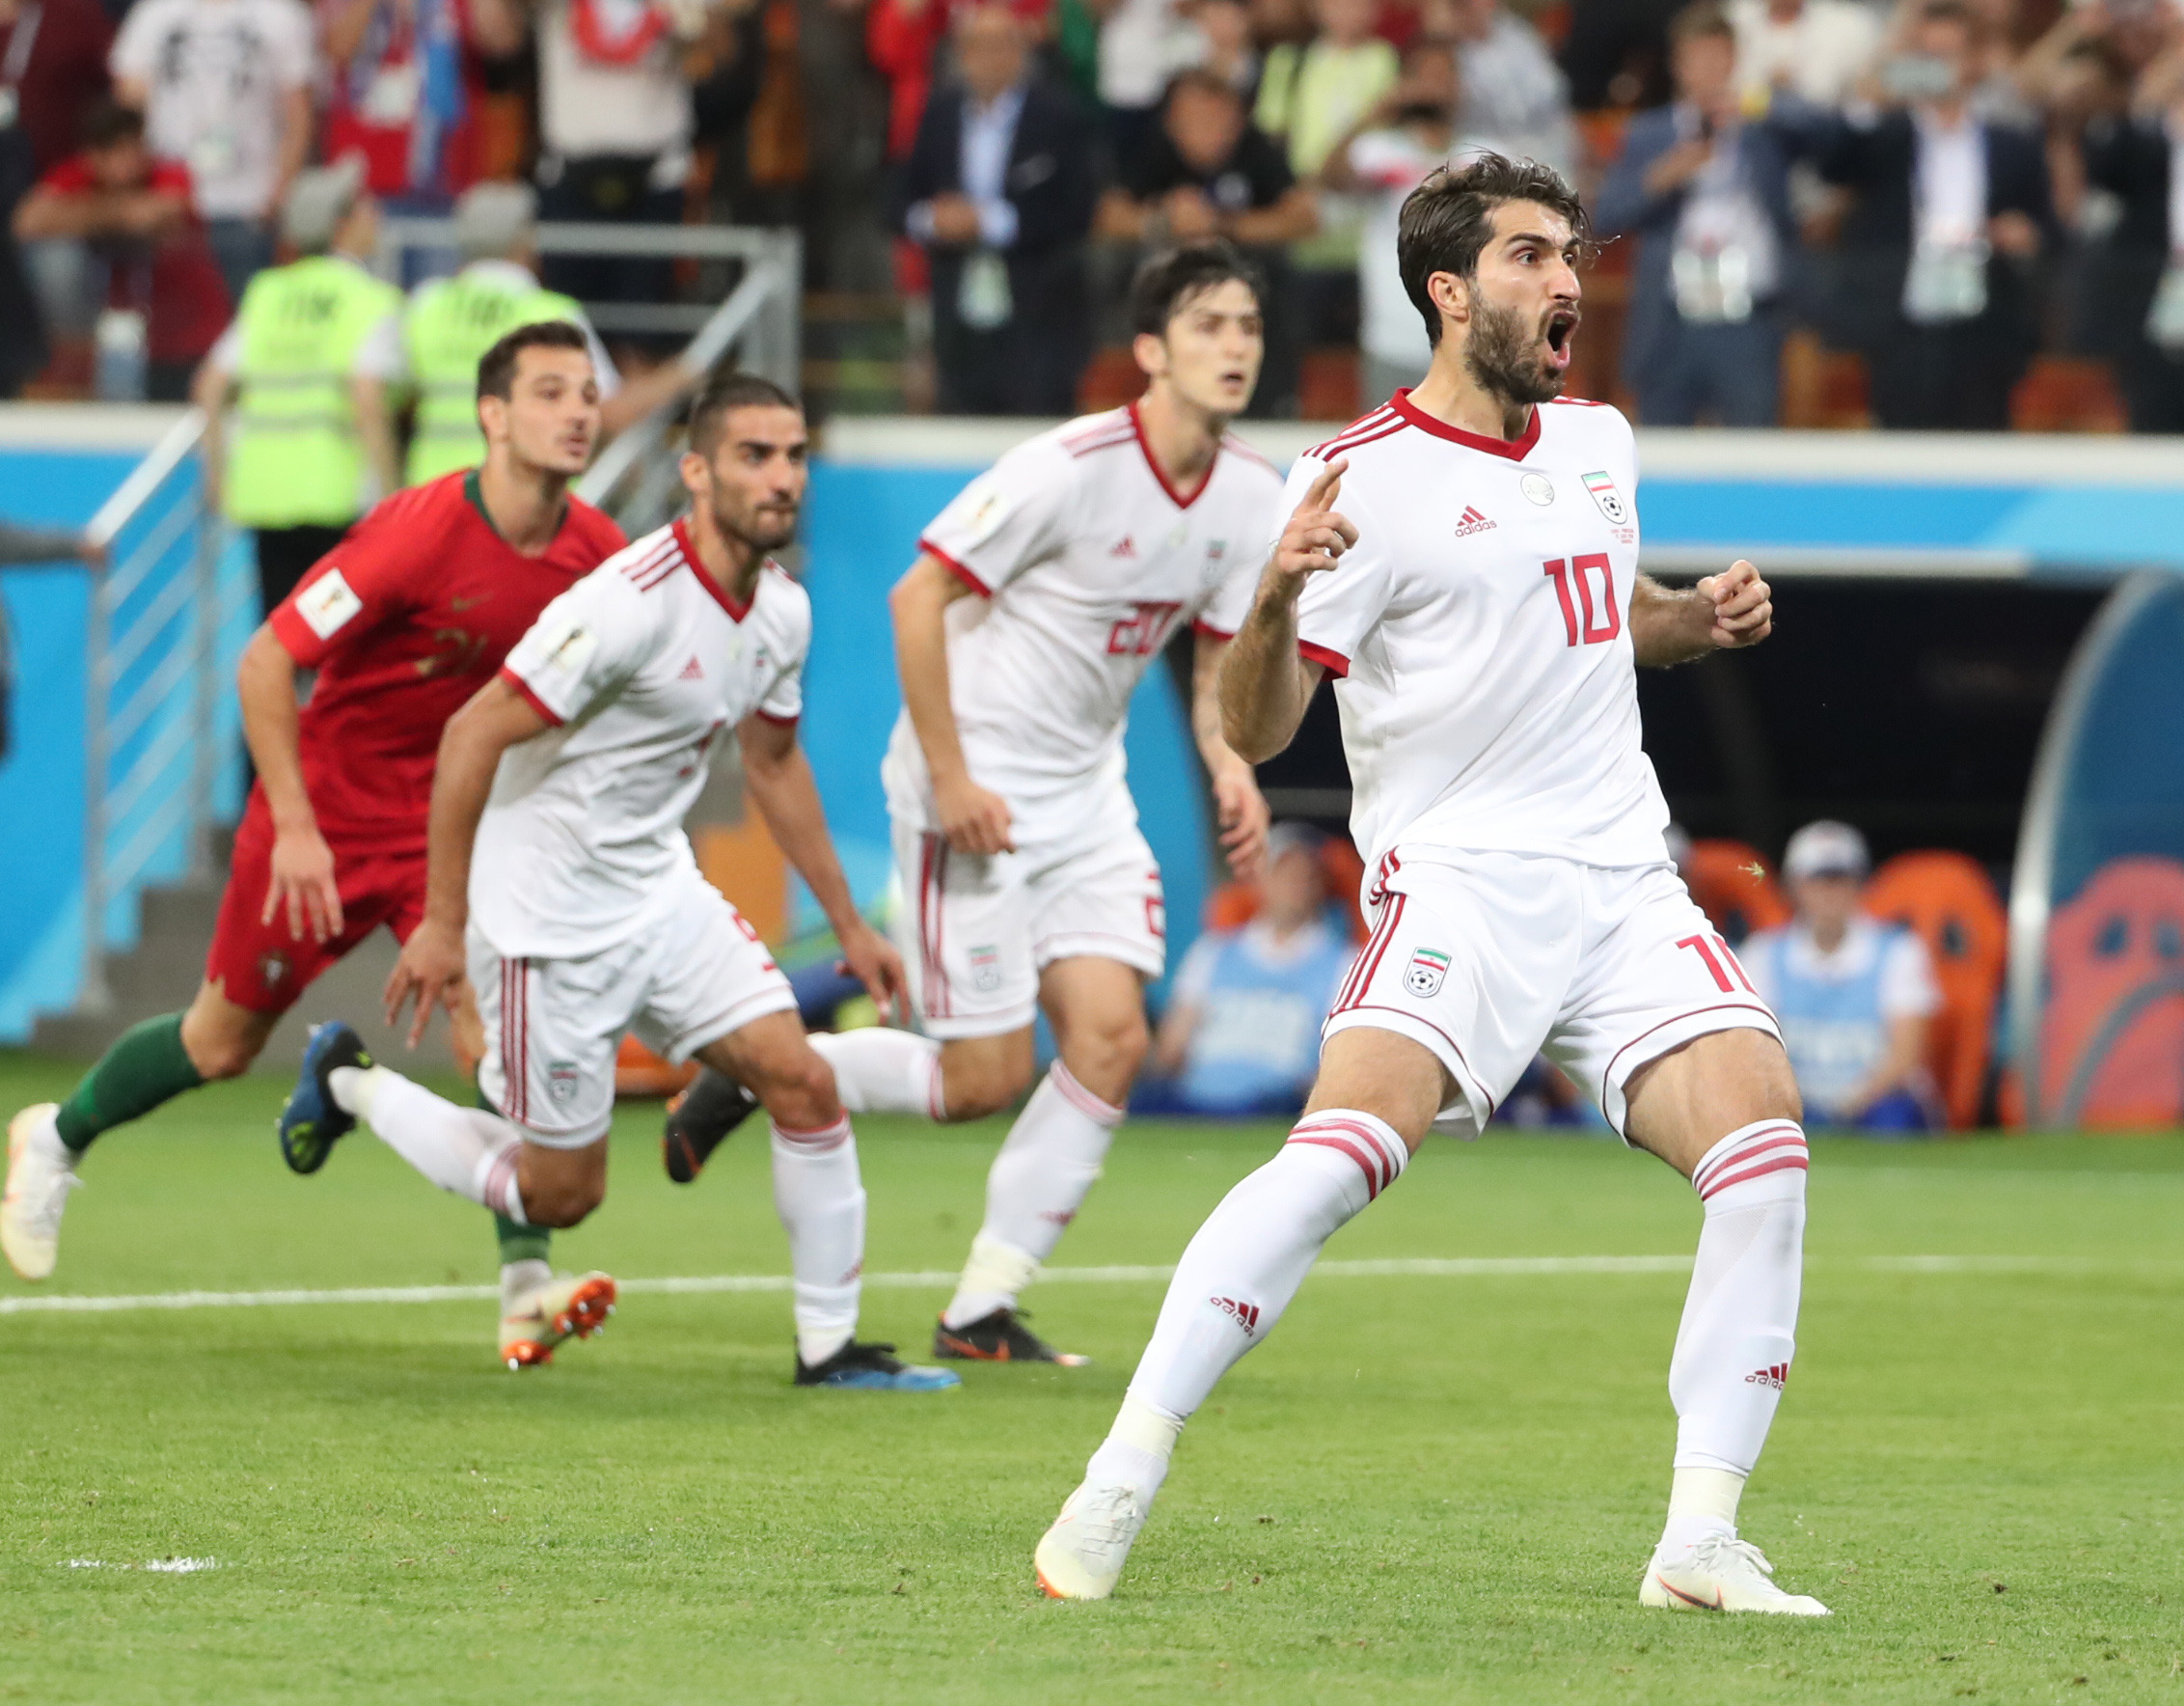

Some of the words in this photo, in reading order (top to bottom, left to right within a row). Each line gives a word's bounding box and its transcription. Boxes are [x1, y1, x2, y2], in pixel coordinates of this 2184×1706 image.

[1455, 519, 1497, 537] adidas
[1542, 552, 1621, 647] 10
[1209, 1296, 1255, 1338] adidas
